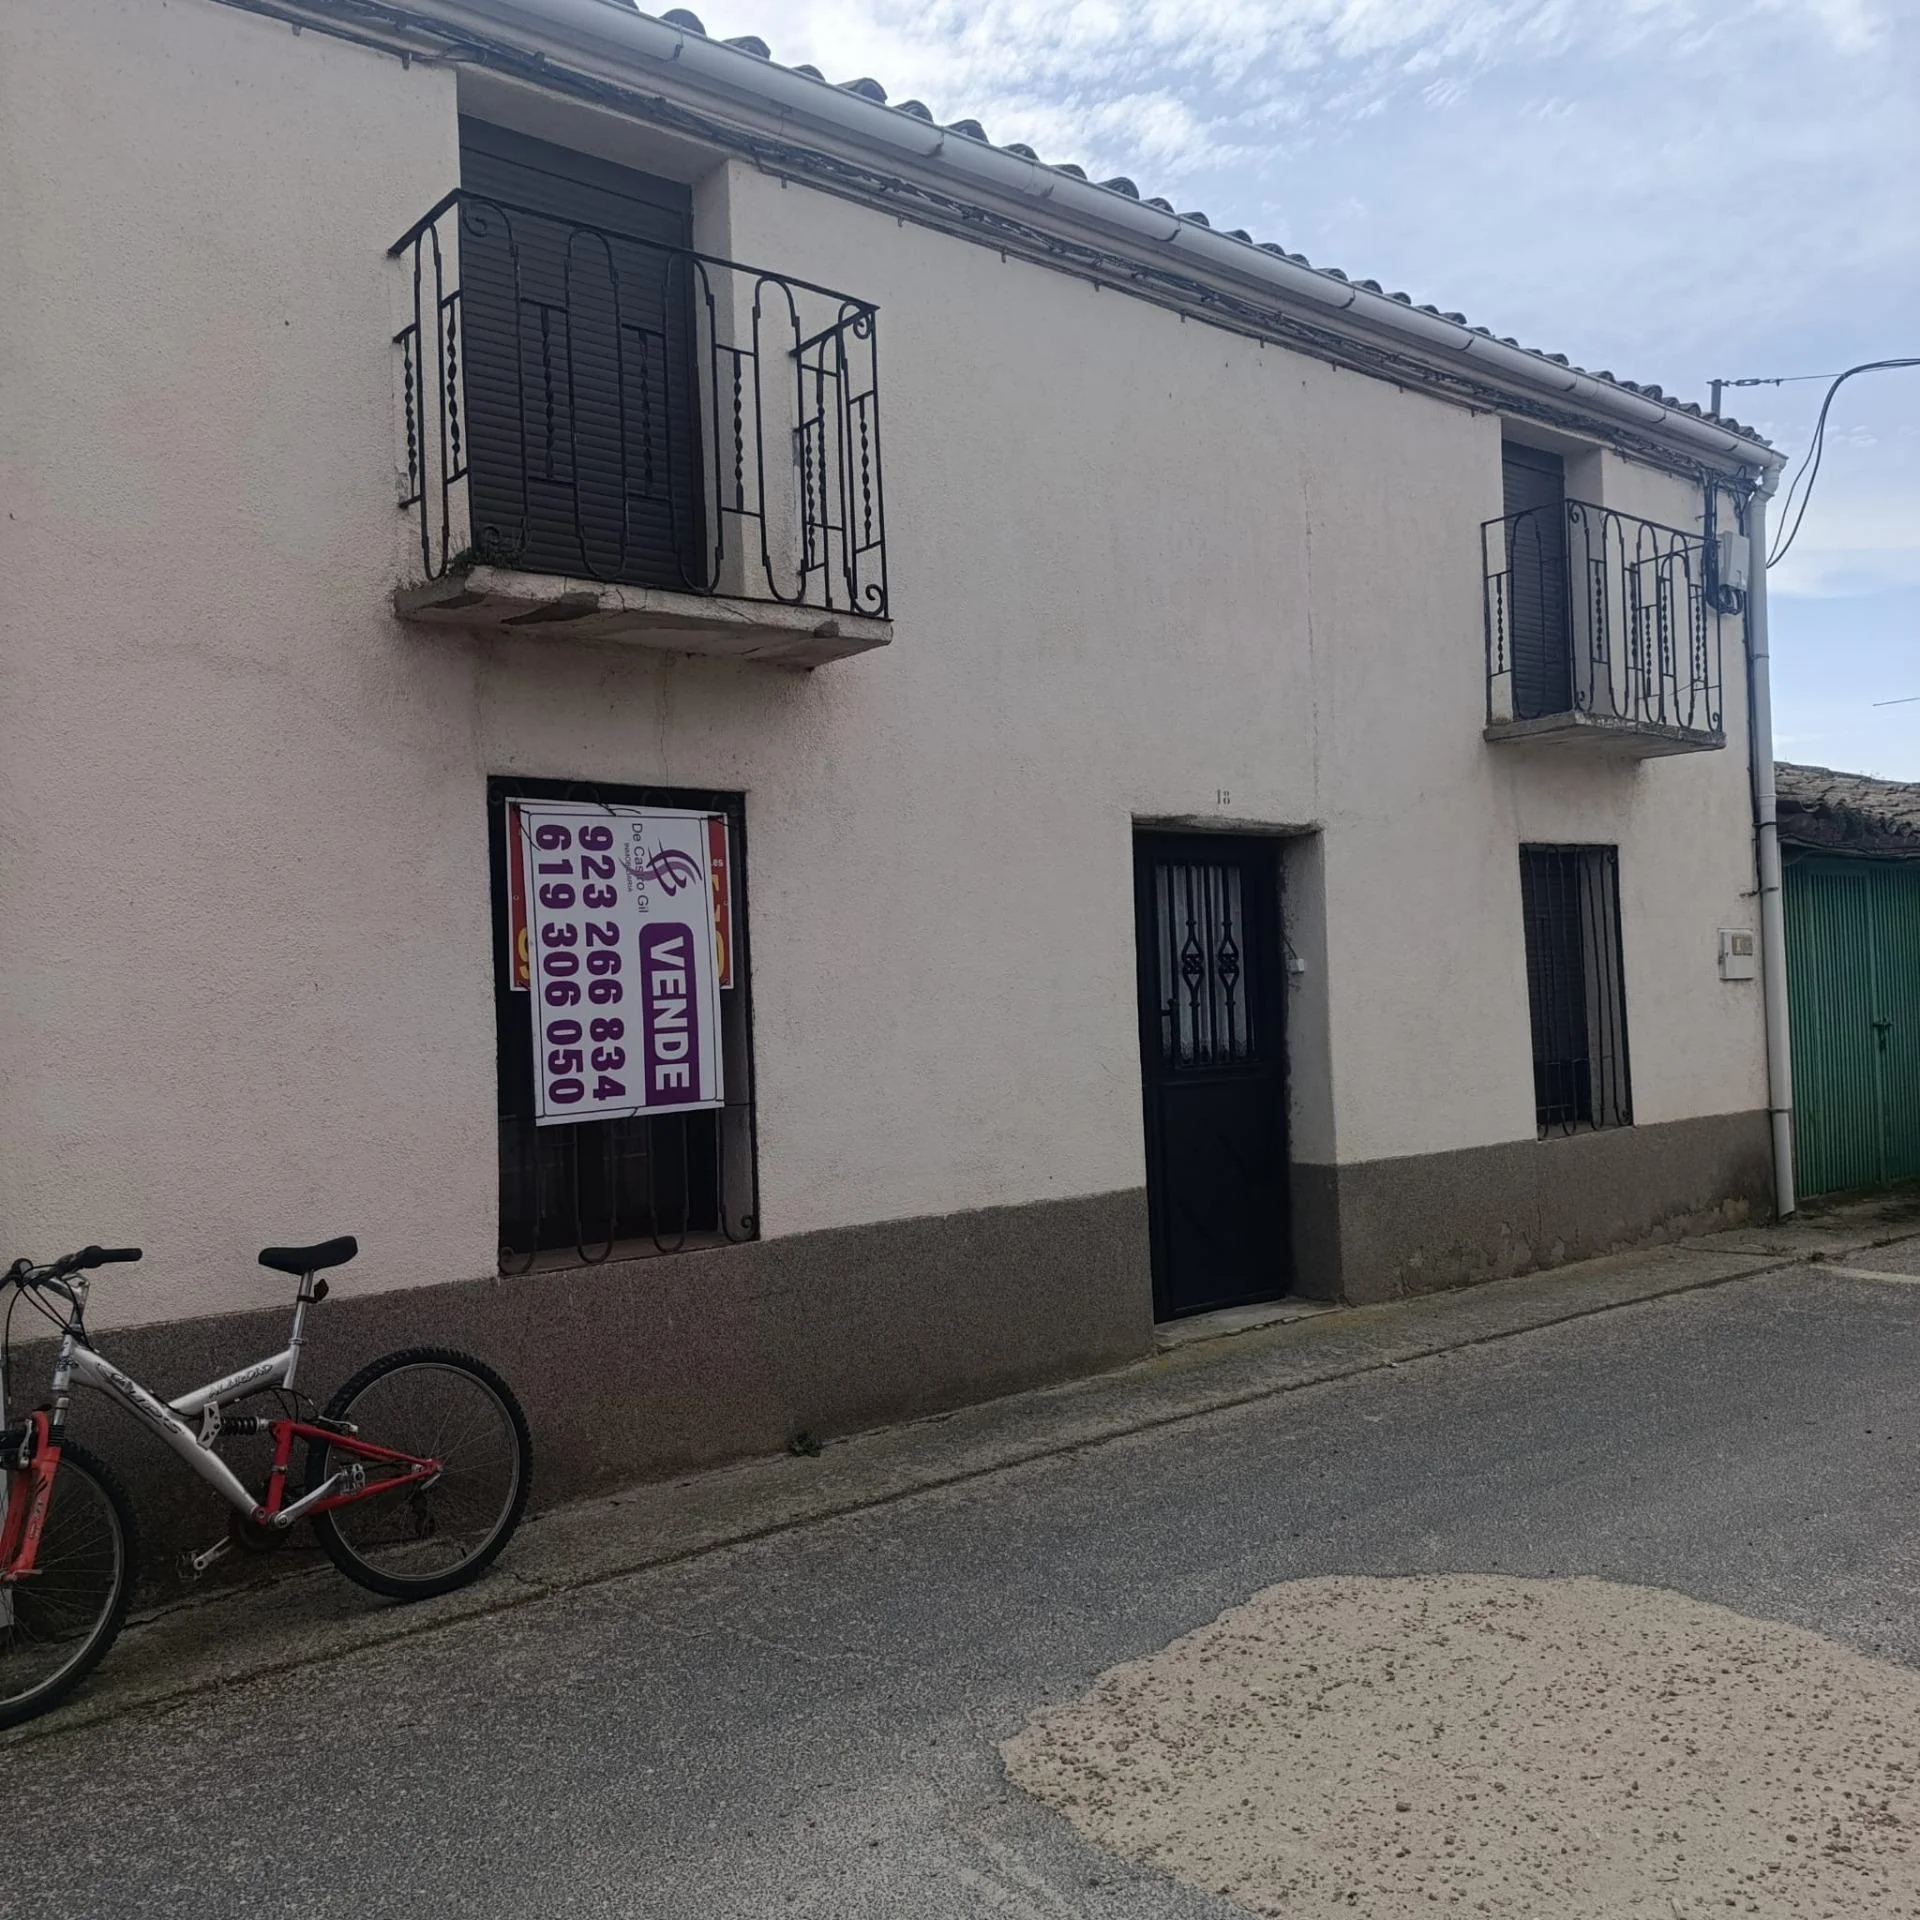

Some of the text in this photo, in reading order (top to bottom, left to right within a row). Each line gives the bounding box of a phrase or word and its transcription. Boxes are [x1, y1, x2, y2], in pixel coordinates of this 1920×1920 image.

[632, 823, 649, 913] De Casro Gil
[1217, 788, 1231, 806] 18
[536, 824, 585, 1104] 619 306 050
[578, 825, 626, 1101] 923 266 834
[650, 936, 690, 1091] VENDE
